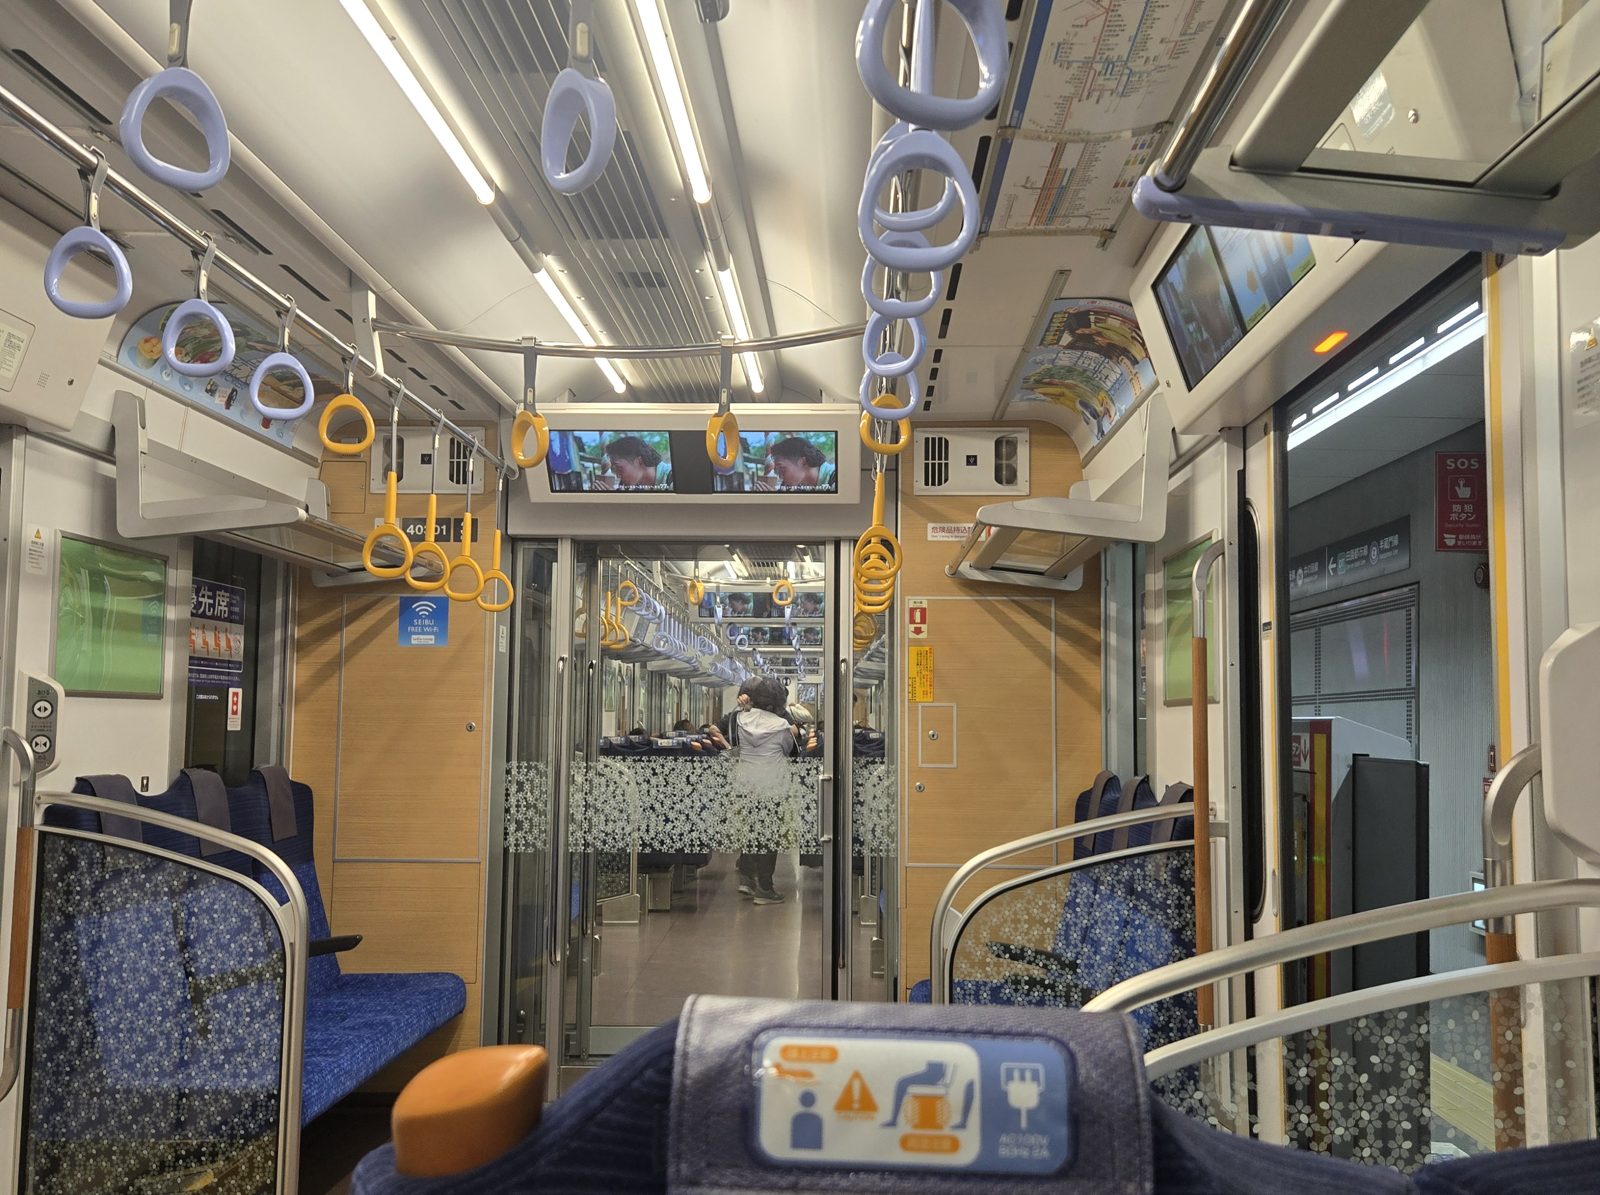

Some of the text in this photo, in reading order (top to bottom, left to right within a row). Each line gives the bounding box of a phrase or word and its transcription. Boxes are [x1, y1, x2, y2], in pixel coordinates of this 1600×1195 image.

[1446, 458, 1480, 470] SOS
[1449, 512, 1476, 521] ボタン
[412, 618, 434, 626] SEIBU
